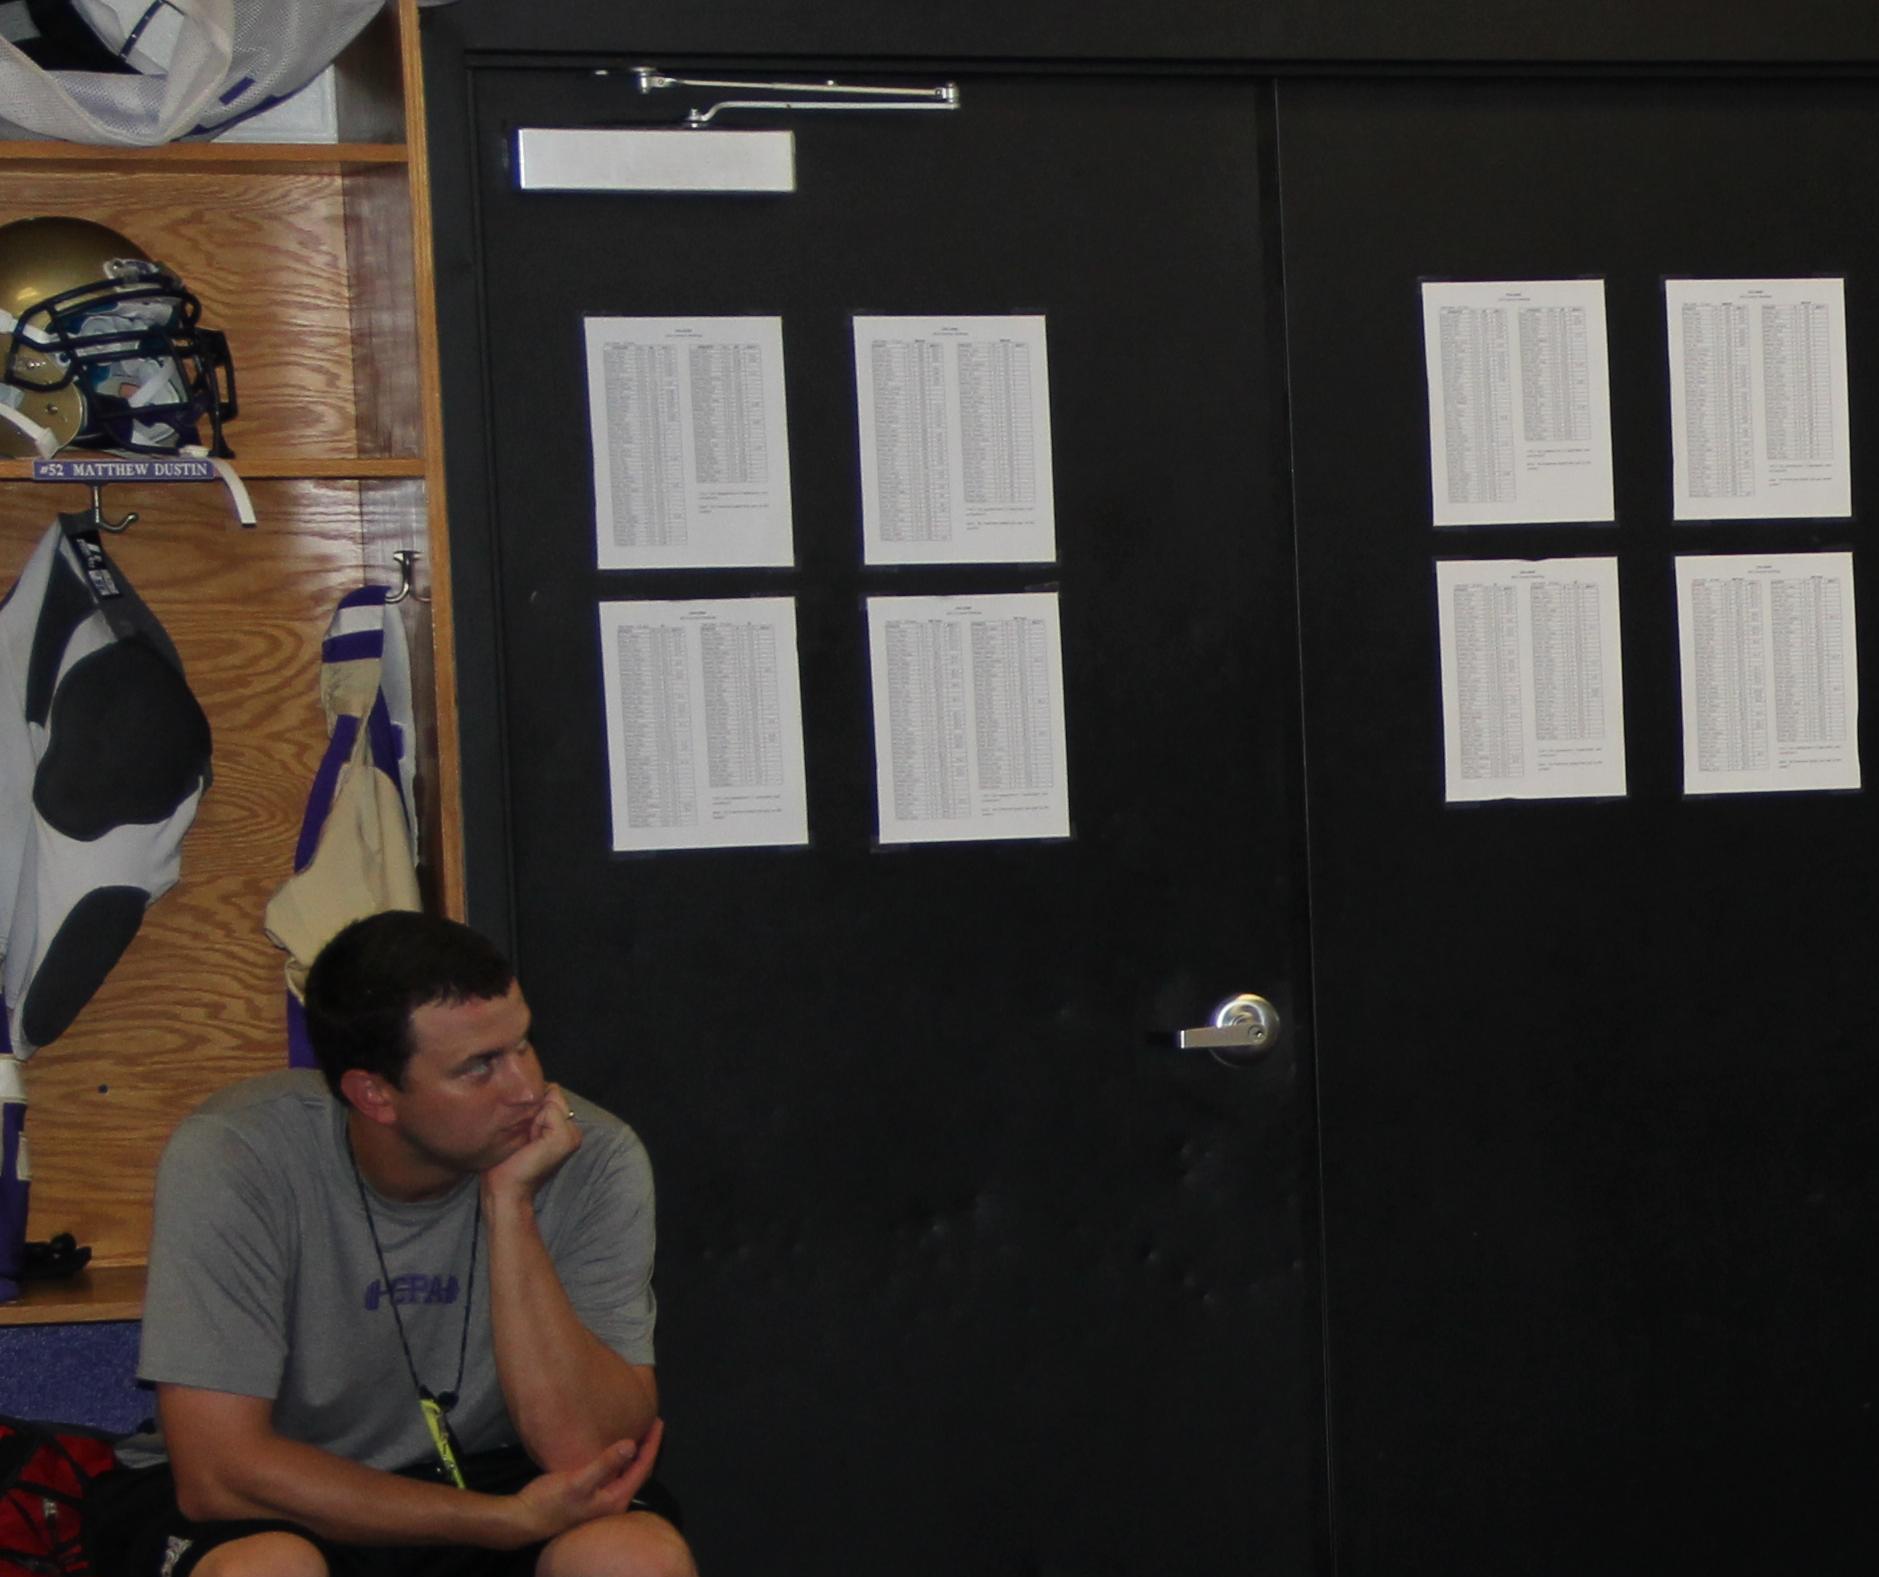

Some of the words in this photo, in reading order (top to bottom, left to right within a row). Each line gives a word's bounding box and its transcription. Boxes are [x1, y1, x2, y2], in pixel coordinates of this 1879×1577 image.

[40, 464, 64, 476] #52
[73, 464, 148, 477] MATTHEW
[154, 463, 208, 476] DUSTIN
